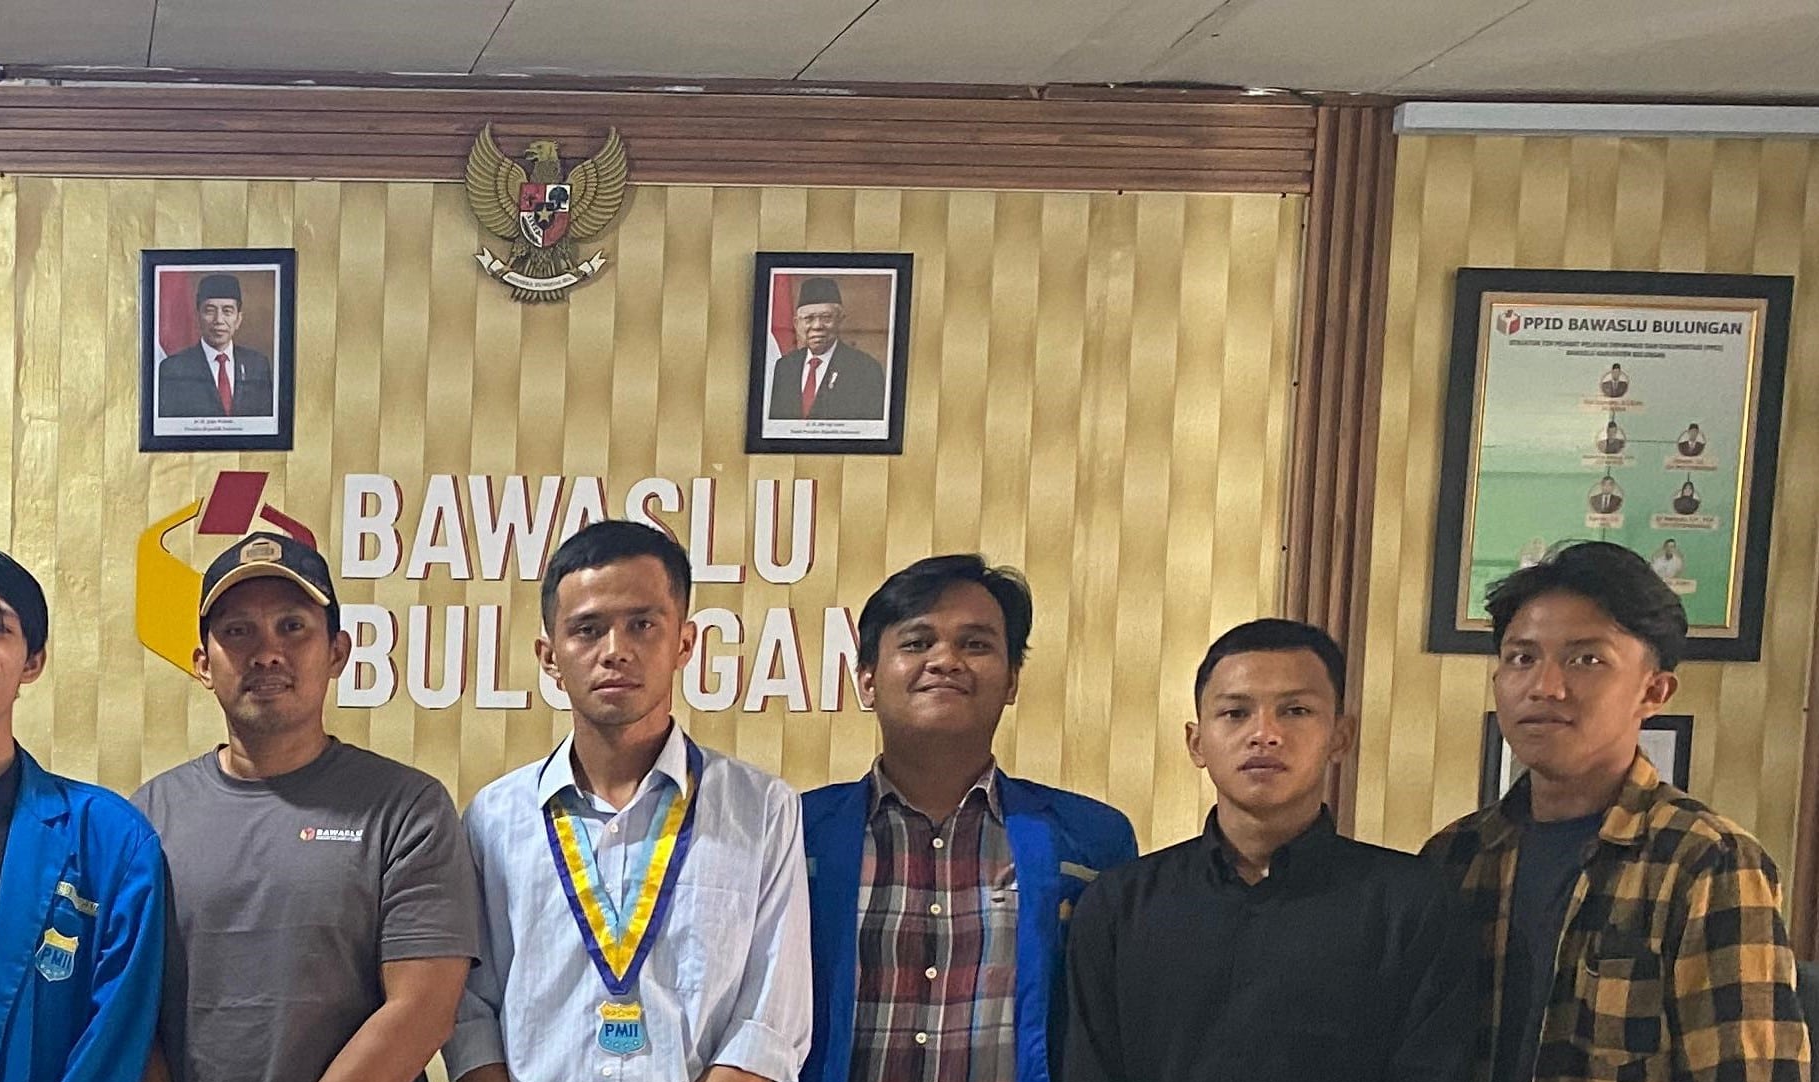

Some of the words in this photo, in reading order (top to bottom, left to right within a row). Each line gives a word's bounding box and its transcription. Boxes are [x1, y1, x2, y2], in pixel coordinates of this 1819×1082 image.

[1523, 316, 1563, 330] PPID
[1568, 317, 1647, 333] BAWASLU
[1652, 320, 1742, 335] BULUNGAN
[337, 603, 874, 713] BULGAN
[605, 1023, 639, 1038] PMII
